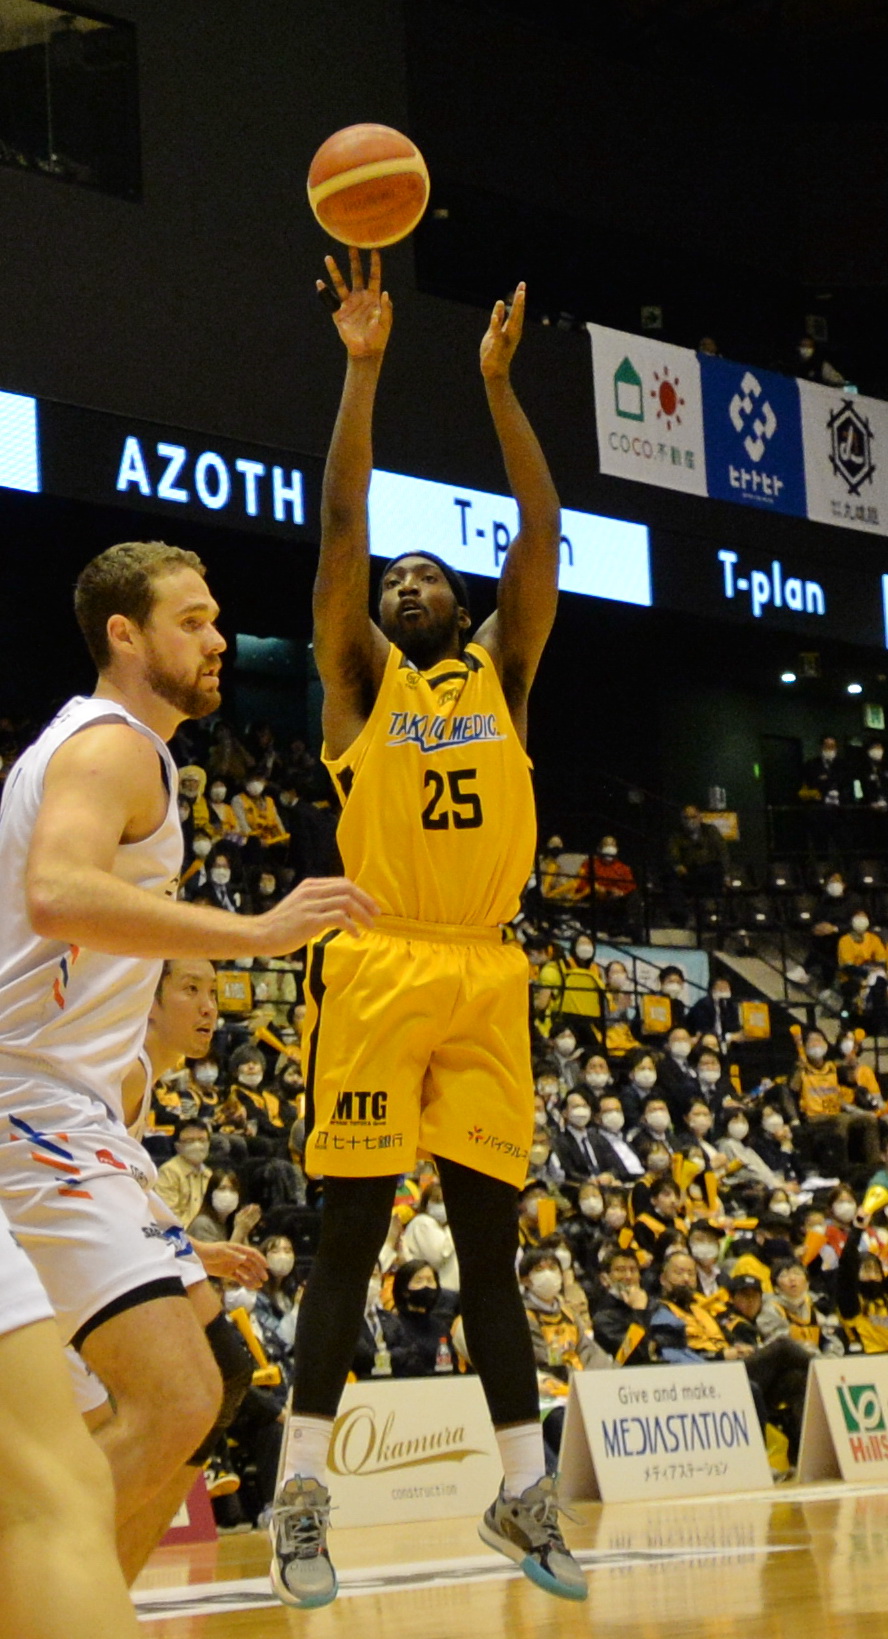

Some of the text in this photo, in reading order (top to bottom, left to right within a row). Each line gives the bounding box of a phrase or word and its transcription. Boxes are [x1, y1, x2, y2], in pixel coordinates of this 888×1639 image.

[116, 436, 304, 525] AZOTH
[453, 497, 574, 567] T-pn
[718, 549, 826, 617] T-plan
[421, 769, 483, 830] 25
[331, 1091, 388, 1121] MTG
[618, 1382, 721, 1405] Give and make.
[326, 1404, 466, 1476] Okamura
[602, 1409, 750, 1459] MEDIASTATION
[391, 1483, 459, 1501] construction
[644, 1462, 729, 1483] メディアステーション
